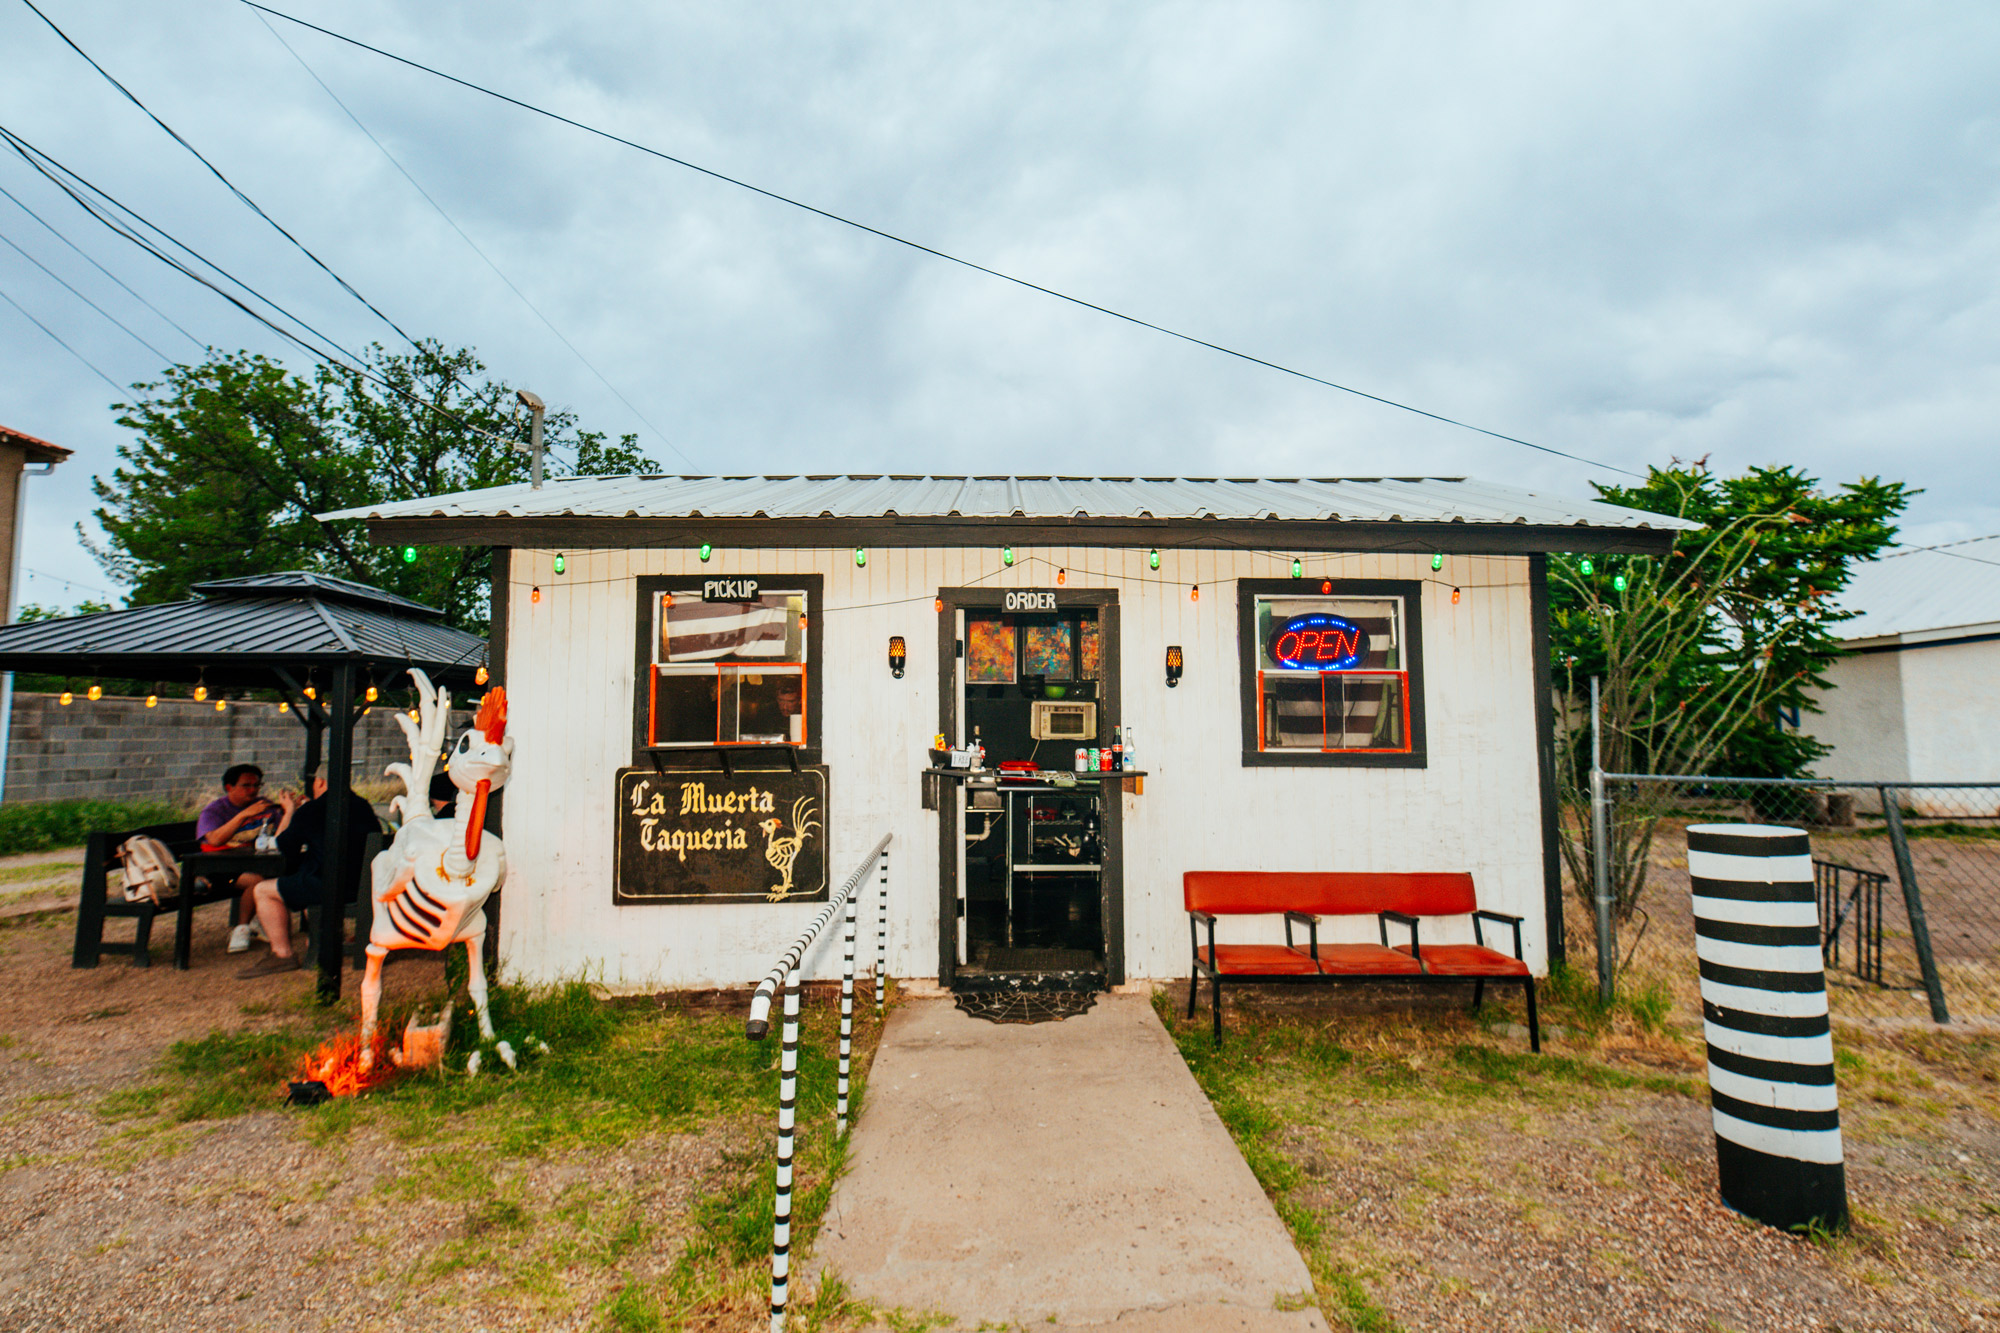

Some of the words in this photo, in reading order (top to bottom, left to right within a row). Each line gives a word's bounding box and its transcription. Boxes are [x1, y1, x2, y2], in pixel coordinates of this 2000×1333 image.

[1005, 591, 1056, 610] ORDER
[1275, 629, 1360, 661] OPEN
[630, 780, 666, 816] La
[679, 781, 775, 816] Muerta
[639, 817, 748, 863] Taqueria
